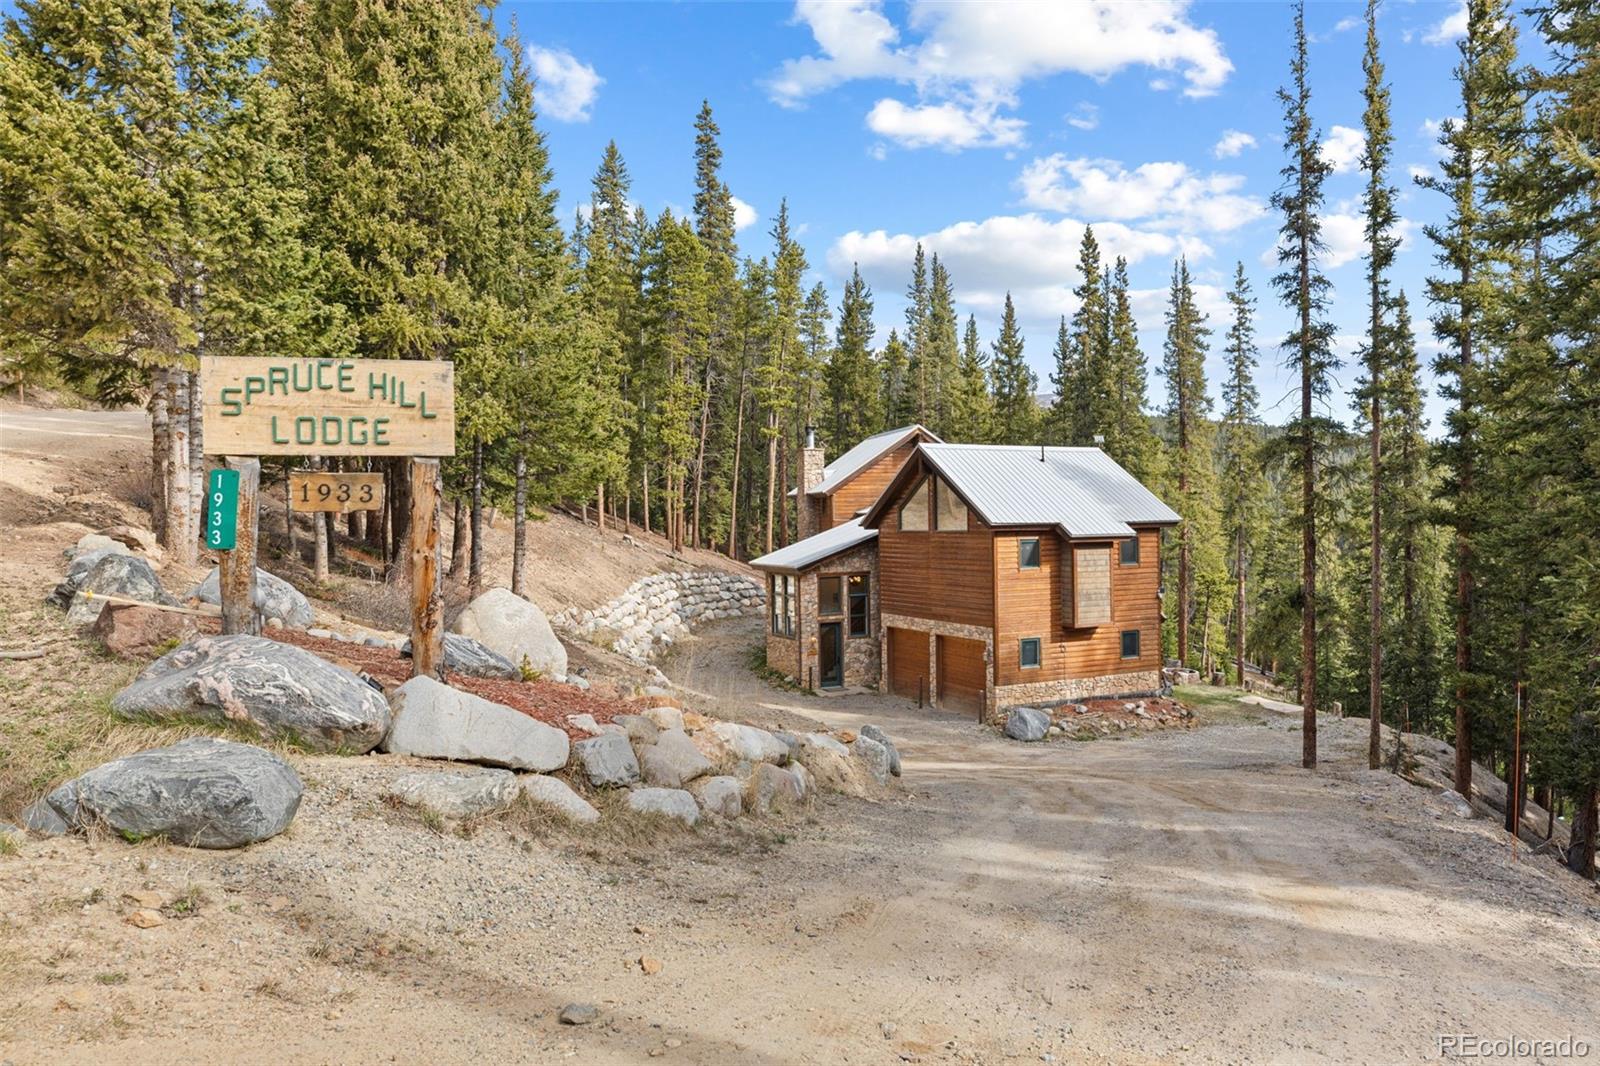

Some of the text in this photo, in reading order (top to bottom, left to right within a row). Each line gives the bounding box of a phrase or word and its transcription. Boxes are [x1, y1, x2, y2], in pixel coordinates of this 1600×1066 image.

[221, 361, 437, 418] SPRUCE HILL
[271, 415, 390, 446] LODGE
[211, 474, 224, 545] 1933
[300, 483, 374, 503] 1933
